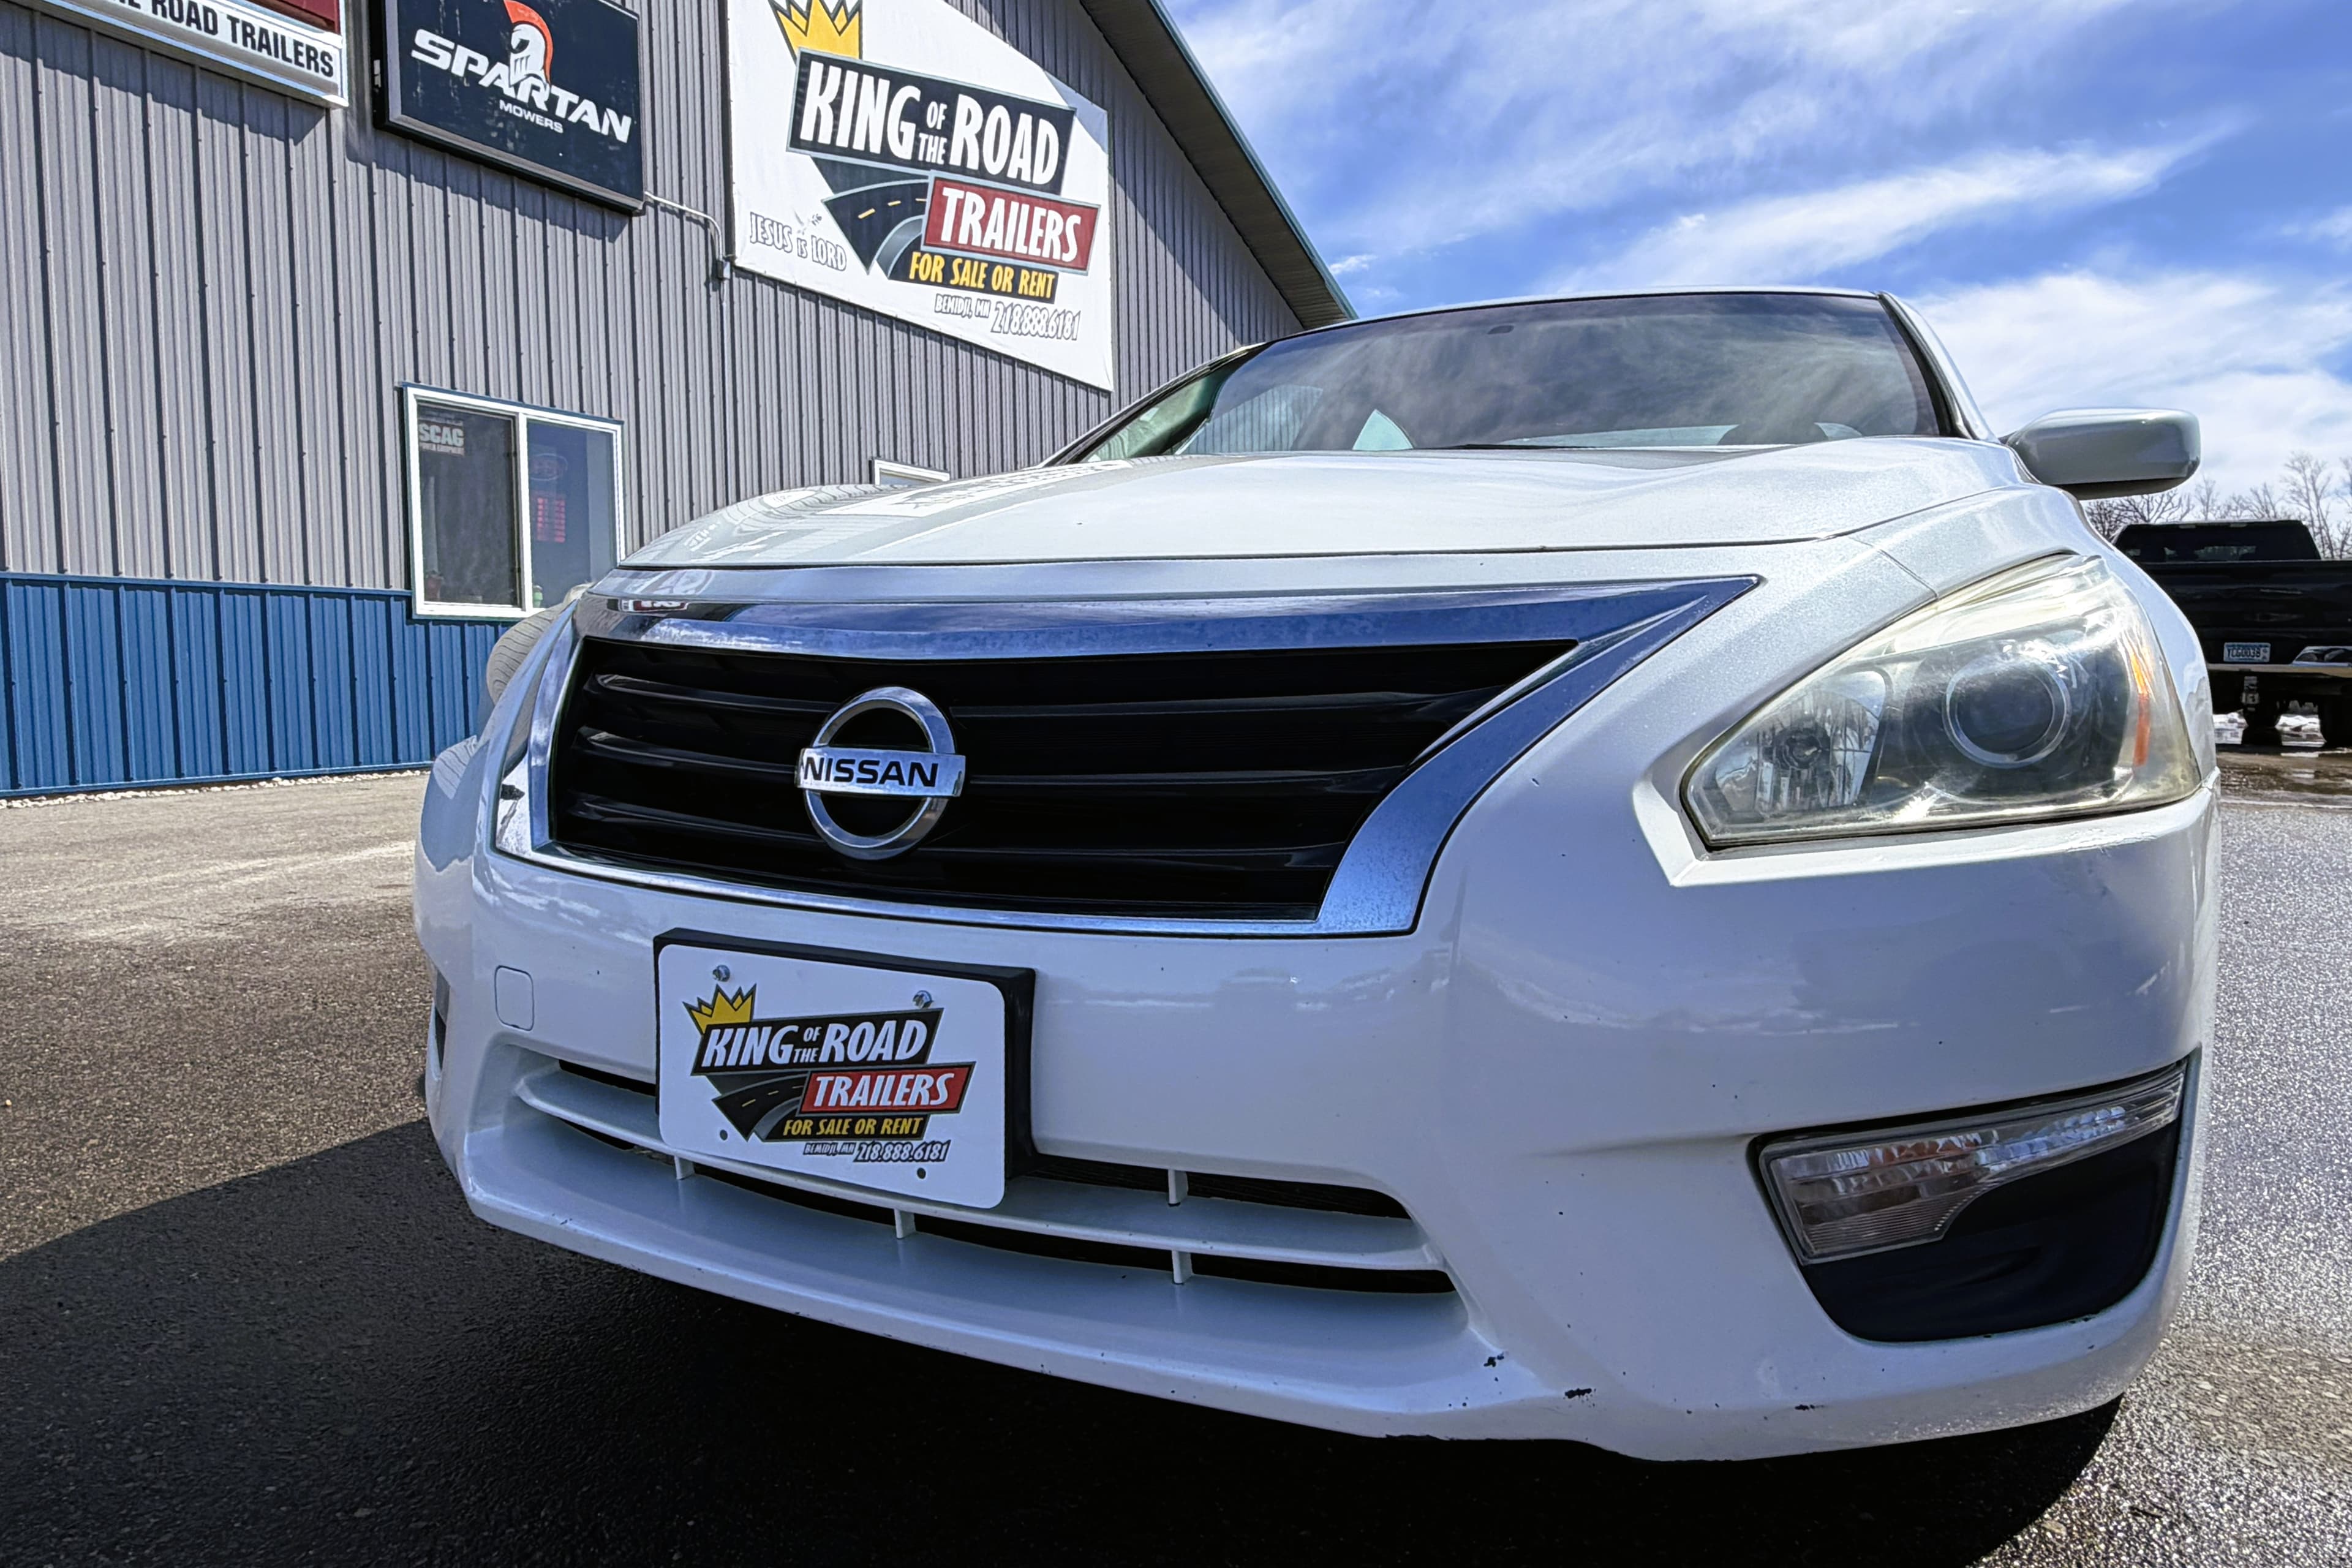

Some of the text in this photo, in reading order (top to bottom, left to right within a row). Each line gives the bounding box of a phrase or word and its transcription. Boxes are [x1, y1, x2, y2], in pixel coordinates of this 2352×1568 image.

[152, 0, 334, 78] ROAD TRAILERS
[411, 29, 631, 143] SPARTAN
[499, 99, 564, 134] MOWERS
[800, 60, 1060, 186] KING OF THE ROAD
[750, 211, 847, 271] JESUS IS LORD
[941, 186, 1082, 263] TRAILERS
[909, 251, 1055, 298] FOR SALE OR RENT
[974, 298, 991, 318] MN
[990, 301, 1081, 341] 218.888.6181
[418, 423, 465, 447] SCAG
[804, 756, 939, 788] NISSAN
[701, 1019, 928, 1068] KING OF THE ROAD
[813, 1072, 955, 1107] TRAILERS
[783, 1117, 923, 1137] FOR SALE OR RENT
[839, 1142, 856, 1155] MN
[854, 1140, 950, 1162] 218.888.6181
